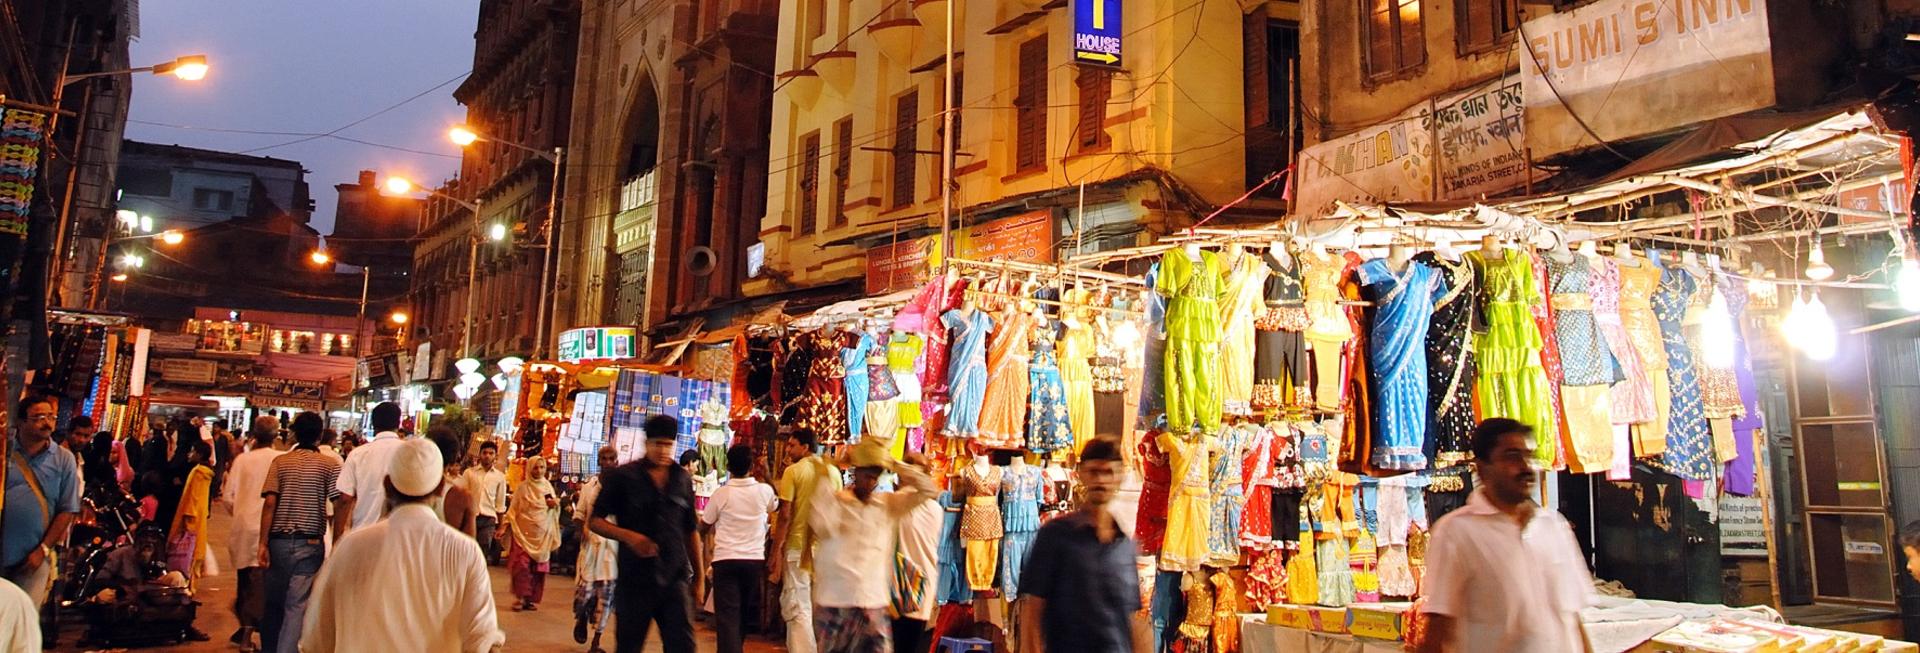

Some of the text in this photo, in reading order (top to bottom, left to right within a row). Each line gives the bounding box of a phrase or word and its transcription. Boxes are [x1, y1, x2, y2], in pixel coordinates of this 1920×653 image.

[1076, 33, 1120, 54] HOUSE
[1530, 0, 1751, 76] SUMI'S INN
[1334, 121, 1409, 176] KHAN
[1481, 158, 1493, 170] OF
